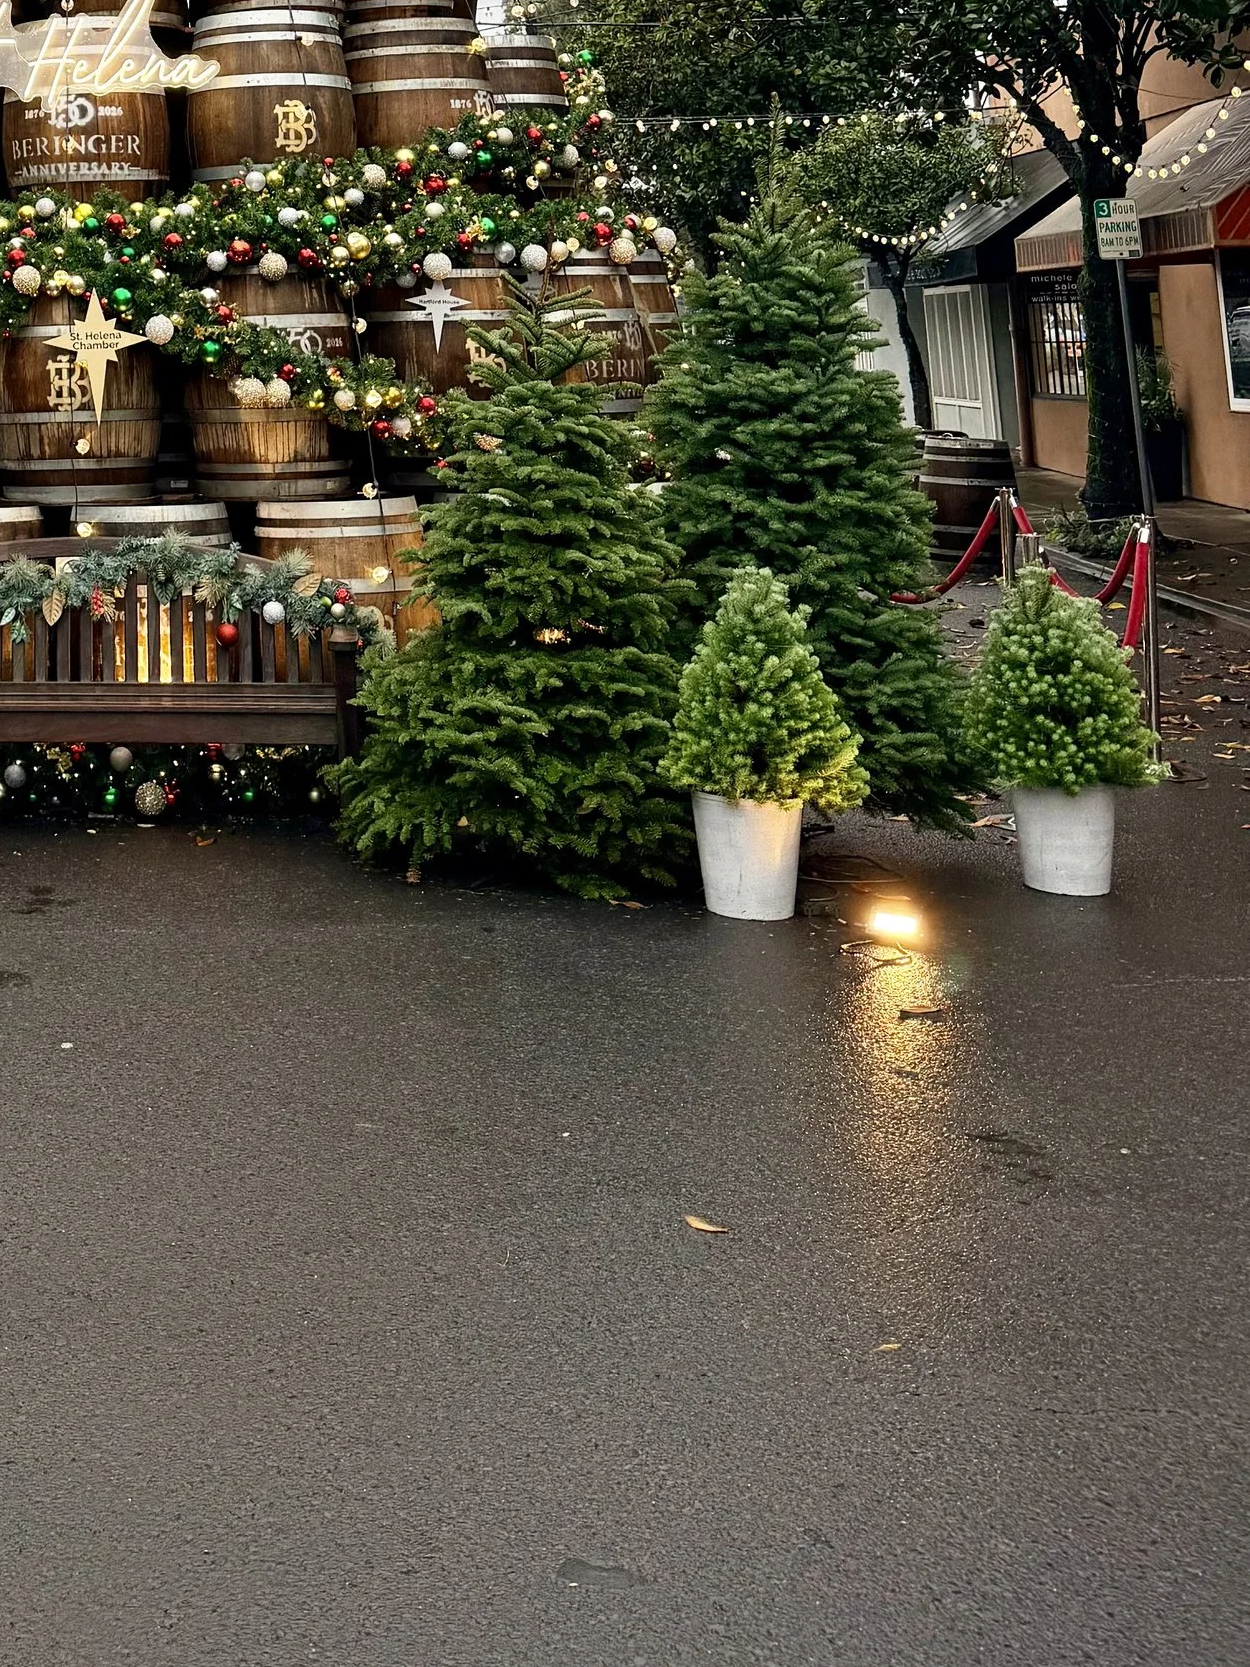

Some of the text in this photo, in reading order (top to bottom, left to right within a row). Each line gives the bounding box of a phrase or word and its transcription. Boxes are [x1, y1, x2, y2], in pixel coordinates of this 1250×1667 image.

[450, 98, 471, 109] 1876
[24, 109, 45, 120] 1876
[97, 105, 124, 117] 2026
[12, 134, 141, 160] BERINGER
[21, 162, 131, 178] ANNIVERSARY
[1098, 202, 1135, 216] 3 HOUR
[1099, 221, 1137, 233] PARKING
[1100, 236, 1139, 247] 8AM TO 6PM
[1031, 274, 1073, 283] michele
[1054, 282, 1077, 291] salo
[1031, 295, 1068, 303] walk-ins
[70, 331, 122, 341] St. Helena
[72, 341, 120, 351] Chamber
[586, 358, 644, 379] BERIN
